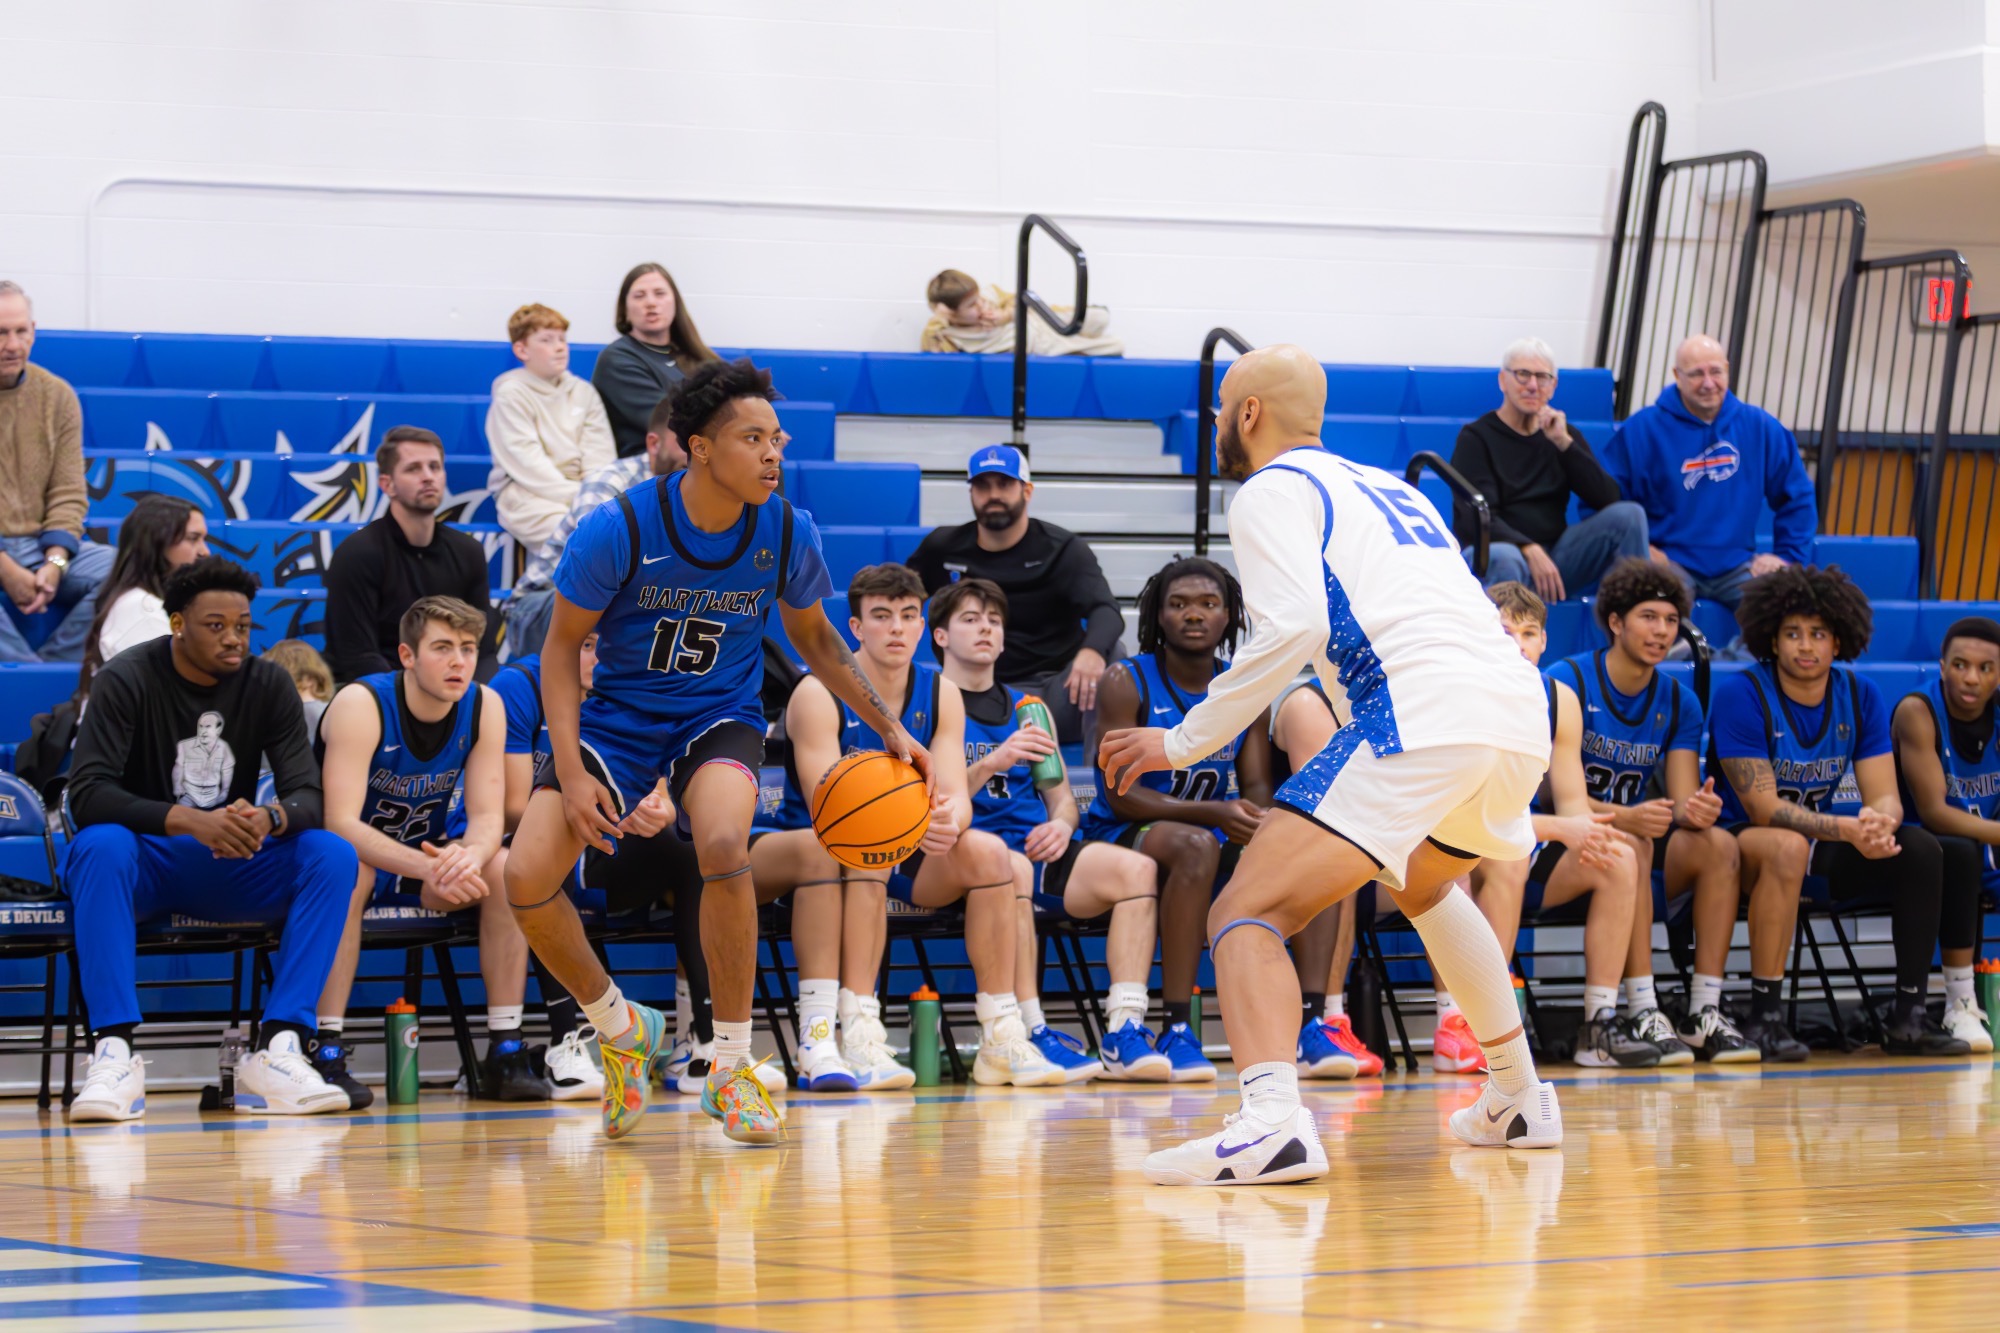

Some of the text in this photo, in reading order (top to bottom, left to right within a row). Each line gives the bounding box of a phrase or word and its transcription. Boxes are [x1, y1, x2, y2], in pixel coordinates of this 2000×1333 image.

[1928, 278, 1973, 321] EX
[1353, 480, 1450, 548] 15
[638, 586, 765, 616] HARTWICK
[647, 617, 726, 675] 15
[369, 768, 460, 798] HARTWIC
[1170, 768, 1220, 801] 10
[370, 799, 442, 842] 22
[13, 910, 66, 924] DEVILS
